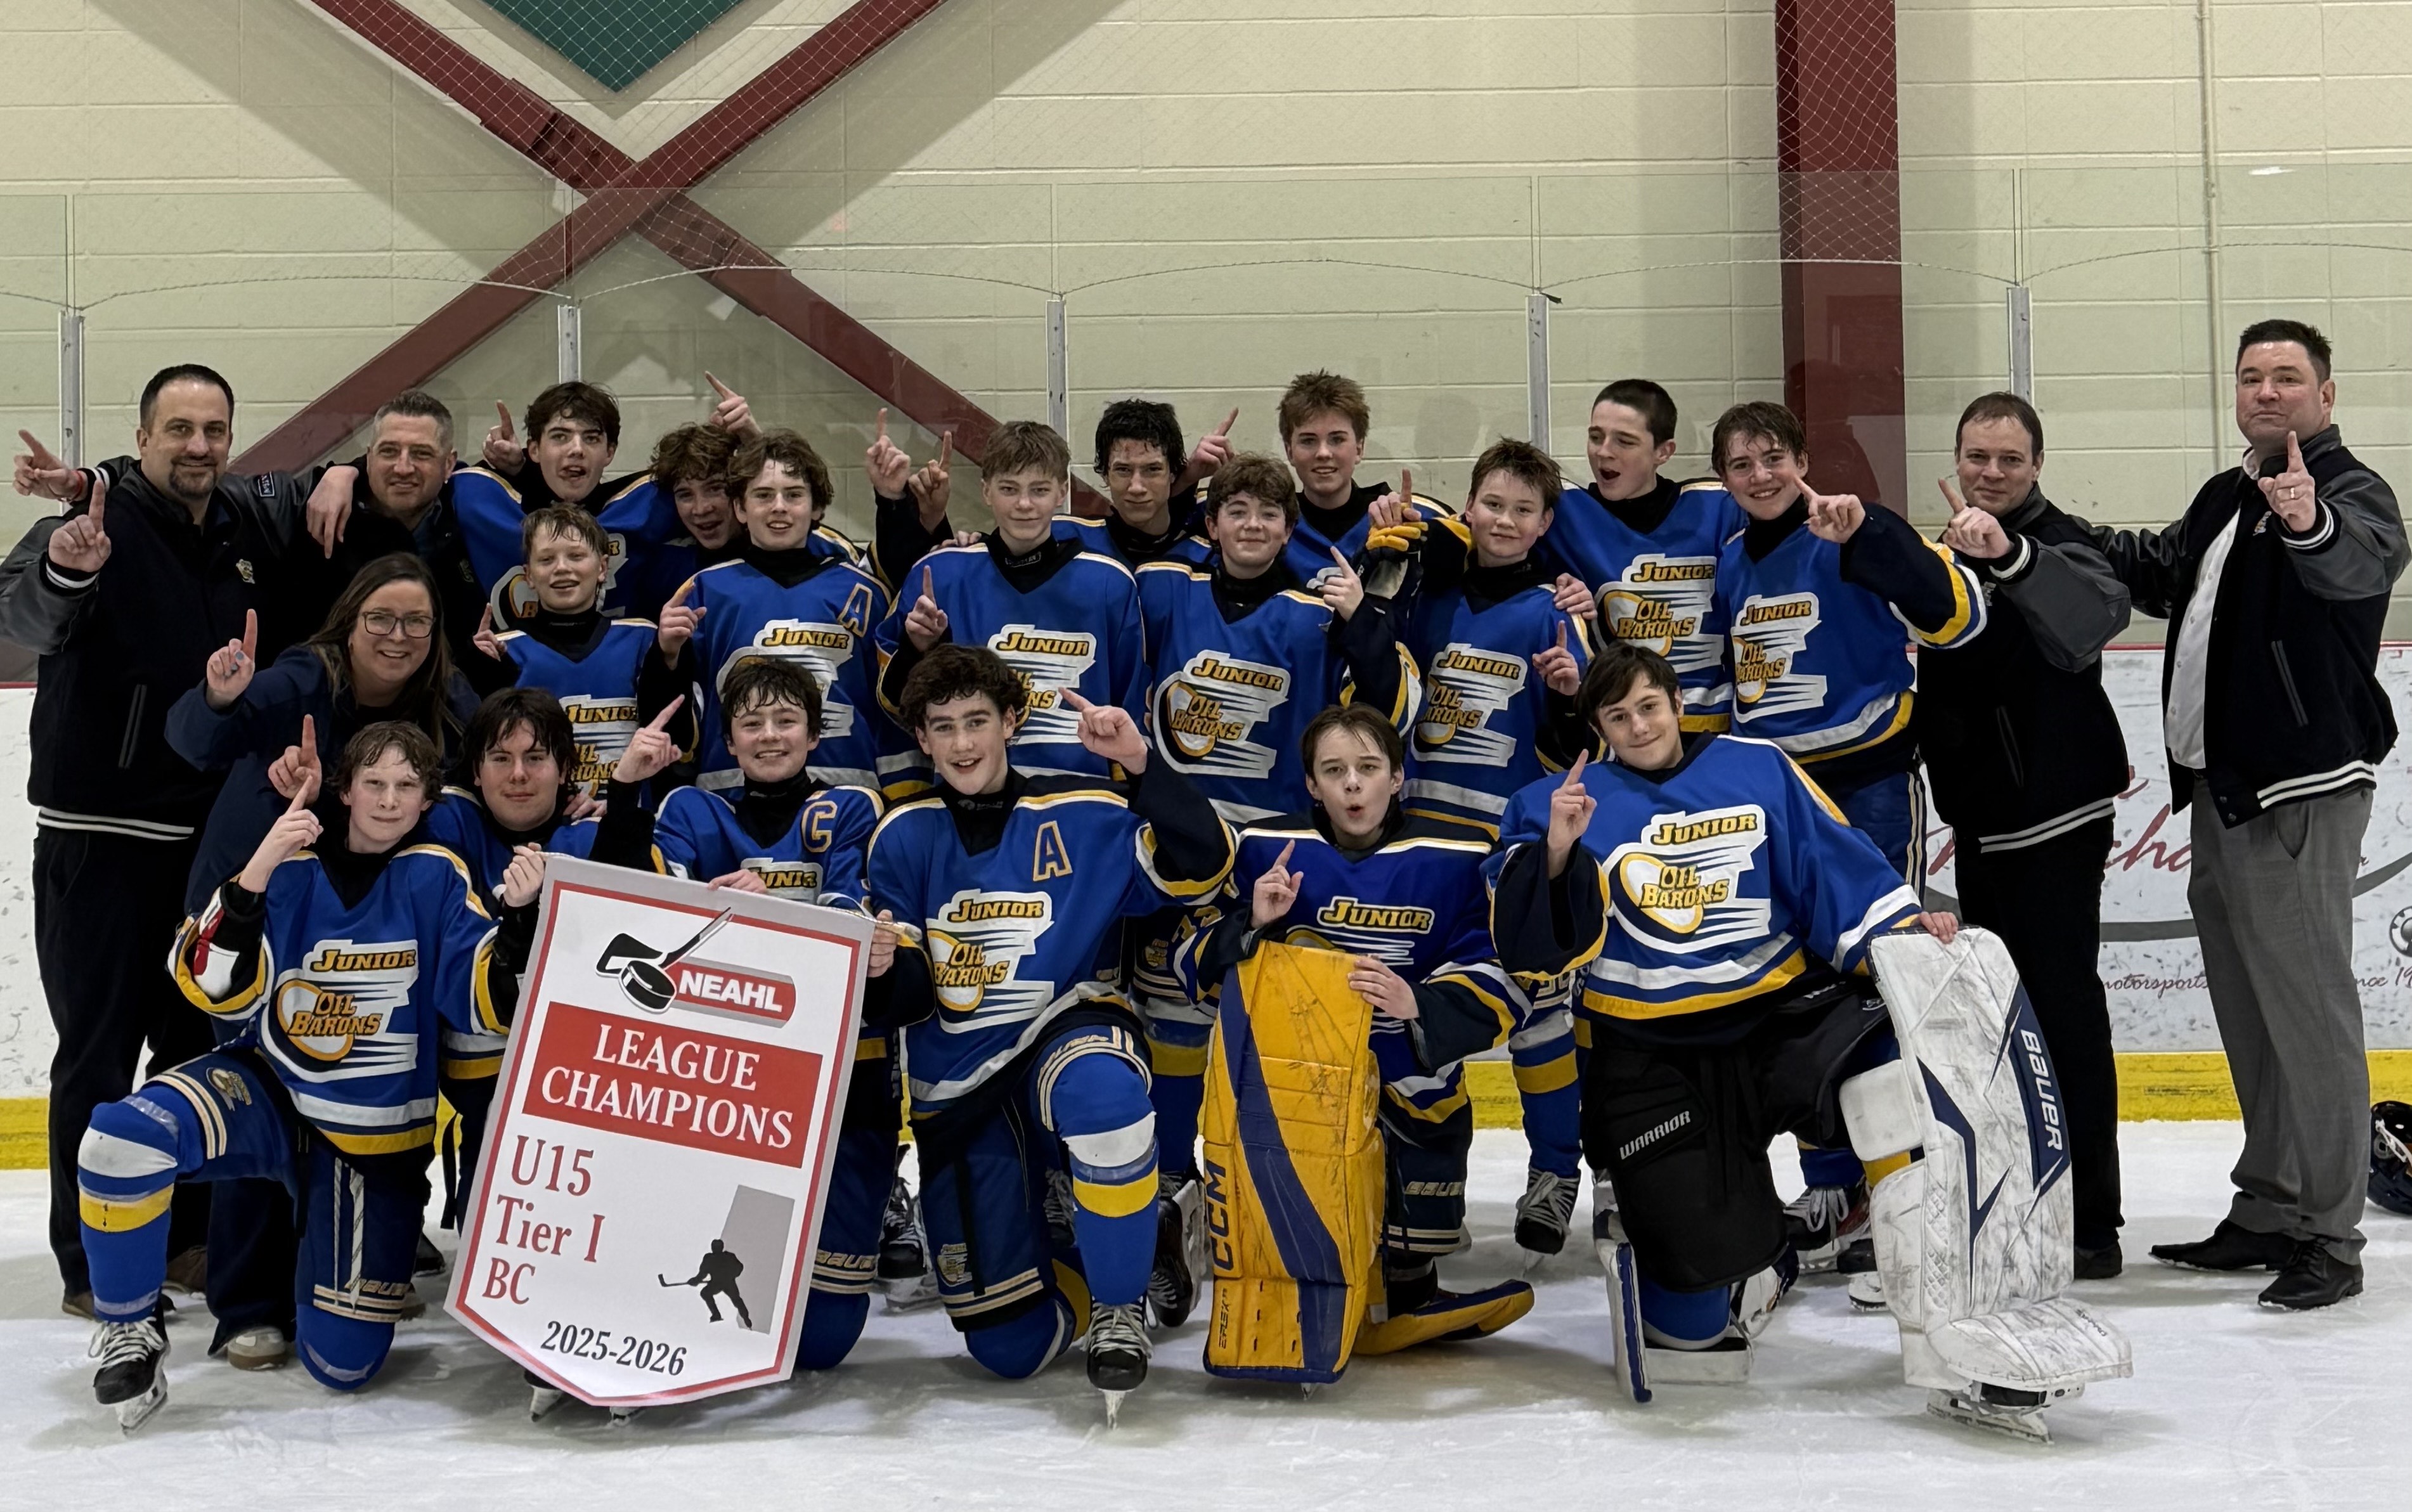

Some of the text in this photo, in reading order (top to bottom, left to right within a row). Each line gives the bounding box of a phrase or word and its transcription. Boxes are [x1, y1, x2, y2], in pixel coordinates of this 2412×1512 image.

[1630, 562, 1715, 582] JUNIOR
[837, 583, 872, 637] A
[1635, 601, 1674, 621] OIL
[1740, 600, 1812, 626] JUNIOR
[762, 628, 849, 649] JUNIOR
[1617, 617, 1696, 639] BARONS
[1437, 650, 1520, 680] JUNIOR
[1741, 642, 1767, 666] OIL
[1191, 657, 1283, 691] JUNIOR
[1186, 695, 1224, 721] OIL
[1429, 685, 1463, 709] OIL
[1172, 709, 1245, 740] BARONS
[1424, 706, 1484, 728] ARONS
[802, 801, 837, 853] C
[1650, 813, 1757, 845] JUNIOR
[1033, 821, 1073, 882] A
[1659, 865, 1701, 888] OIL
[1640, 878, 1730, 909] BARONS
[947, 899, 1044, 922] JUNIOR
[1321, 900, 1432, 931] JUNIOR
[310, 949, 416, 972] JUNIOR
[950, 941, 986, 967] OIL
[934, 960, 1009, 987] BARONS
[313, 992, 357, 1016] OIL
[680, 970, 782, 1012] NEAHL
[287, 1011, 383, 1037] BARONS
[593, 1024, 760, 1091] LEAGUE
[2021, 1029, 2063, 1151] BAUER
[542, 1066, 793, 1149] CHAMPIONS
[1619, 1111, 1691, 1160] WARRIOR
[511, 1135, 594, 1196] U15
[496, 1194, 606, 1263] Tier I
[1205, 1159, 1234, 1271] CCM
[483, 1257, 536, 1305] BC
[541, 1321, 687, 1376] 2025-2026
